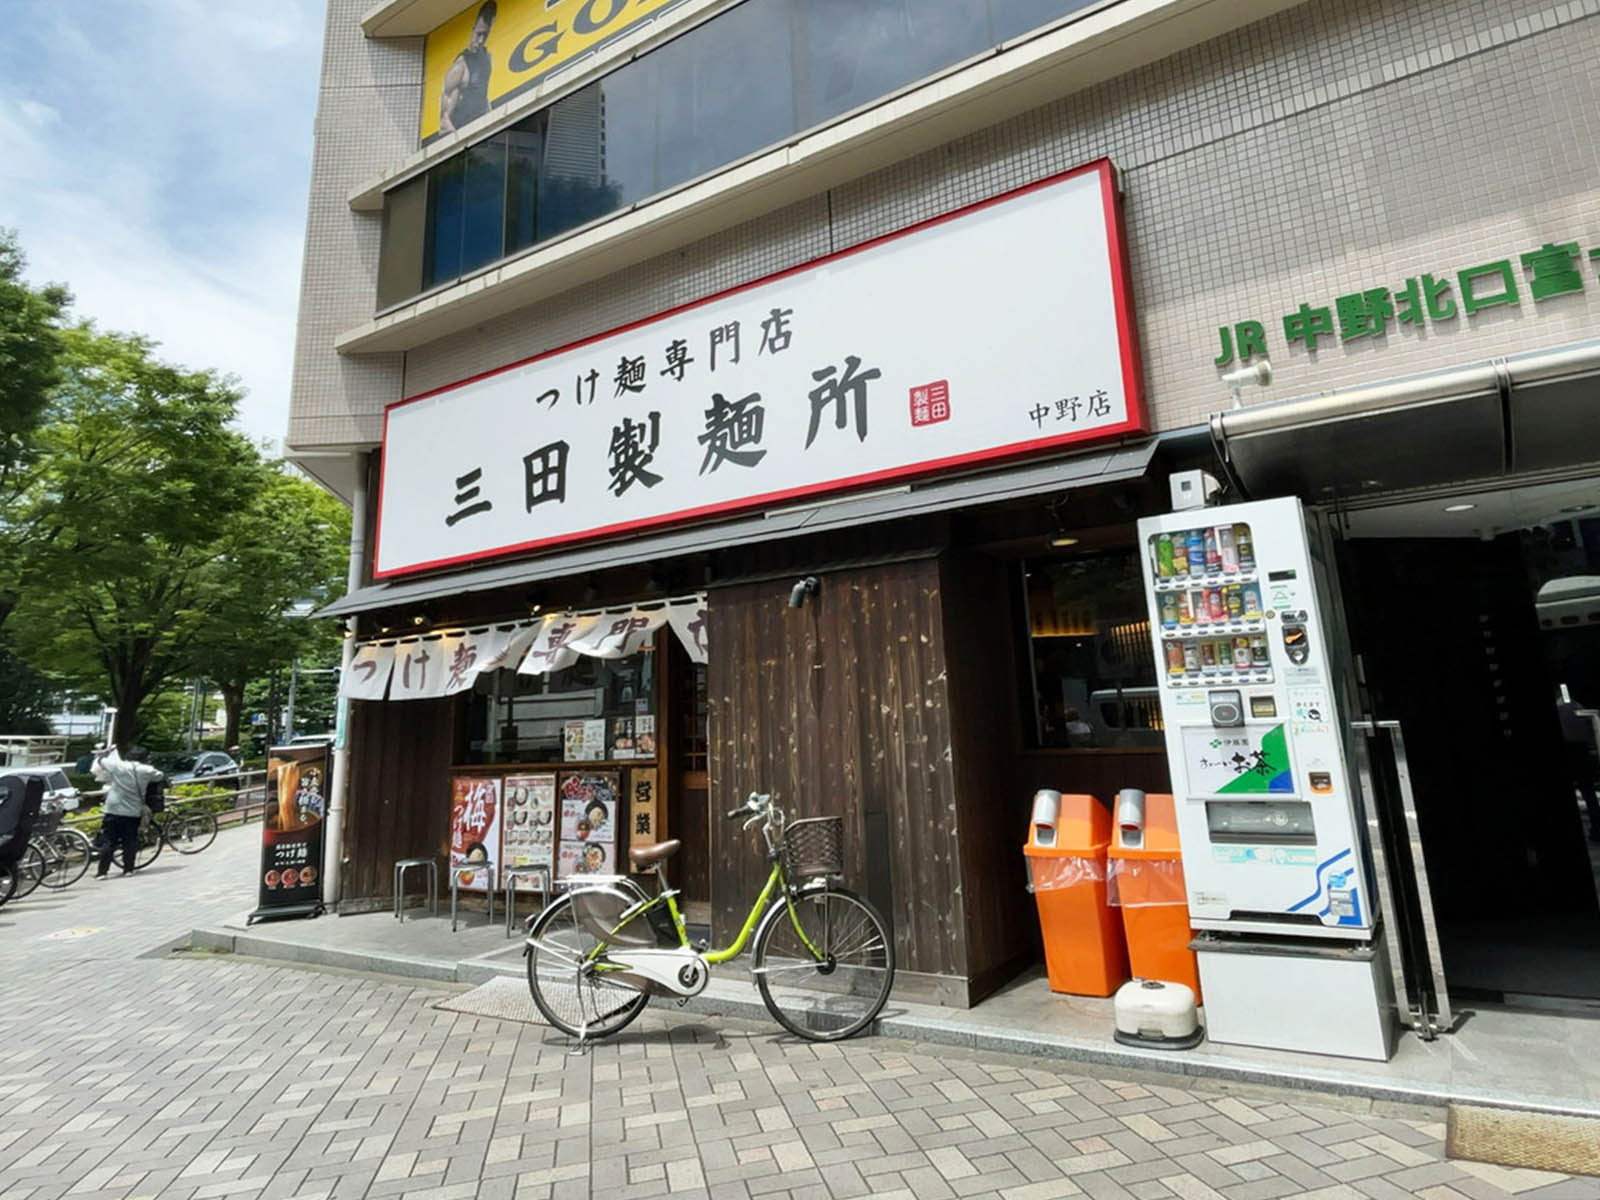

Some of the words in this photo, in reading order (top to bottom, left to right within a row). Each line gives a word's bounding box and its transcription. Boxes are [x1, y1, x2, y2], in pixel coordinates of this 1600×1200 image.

[507, 0, 650, 73] GO
[1214, 320, 1268, 367] JR
[1282, 241, 1600, 350] 中野北口富
[535, 307, 794, 410] つけ麺専門店
[445, 354, 882, 528] 三田製麺所
[1028, 389, 1111, 430] 中野店
[634, 781, 652, 840] 営業
